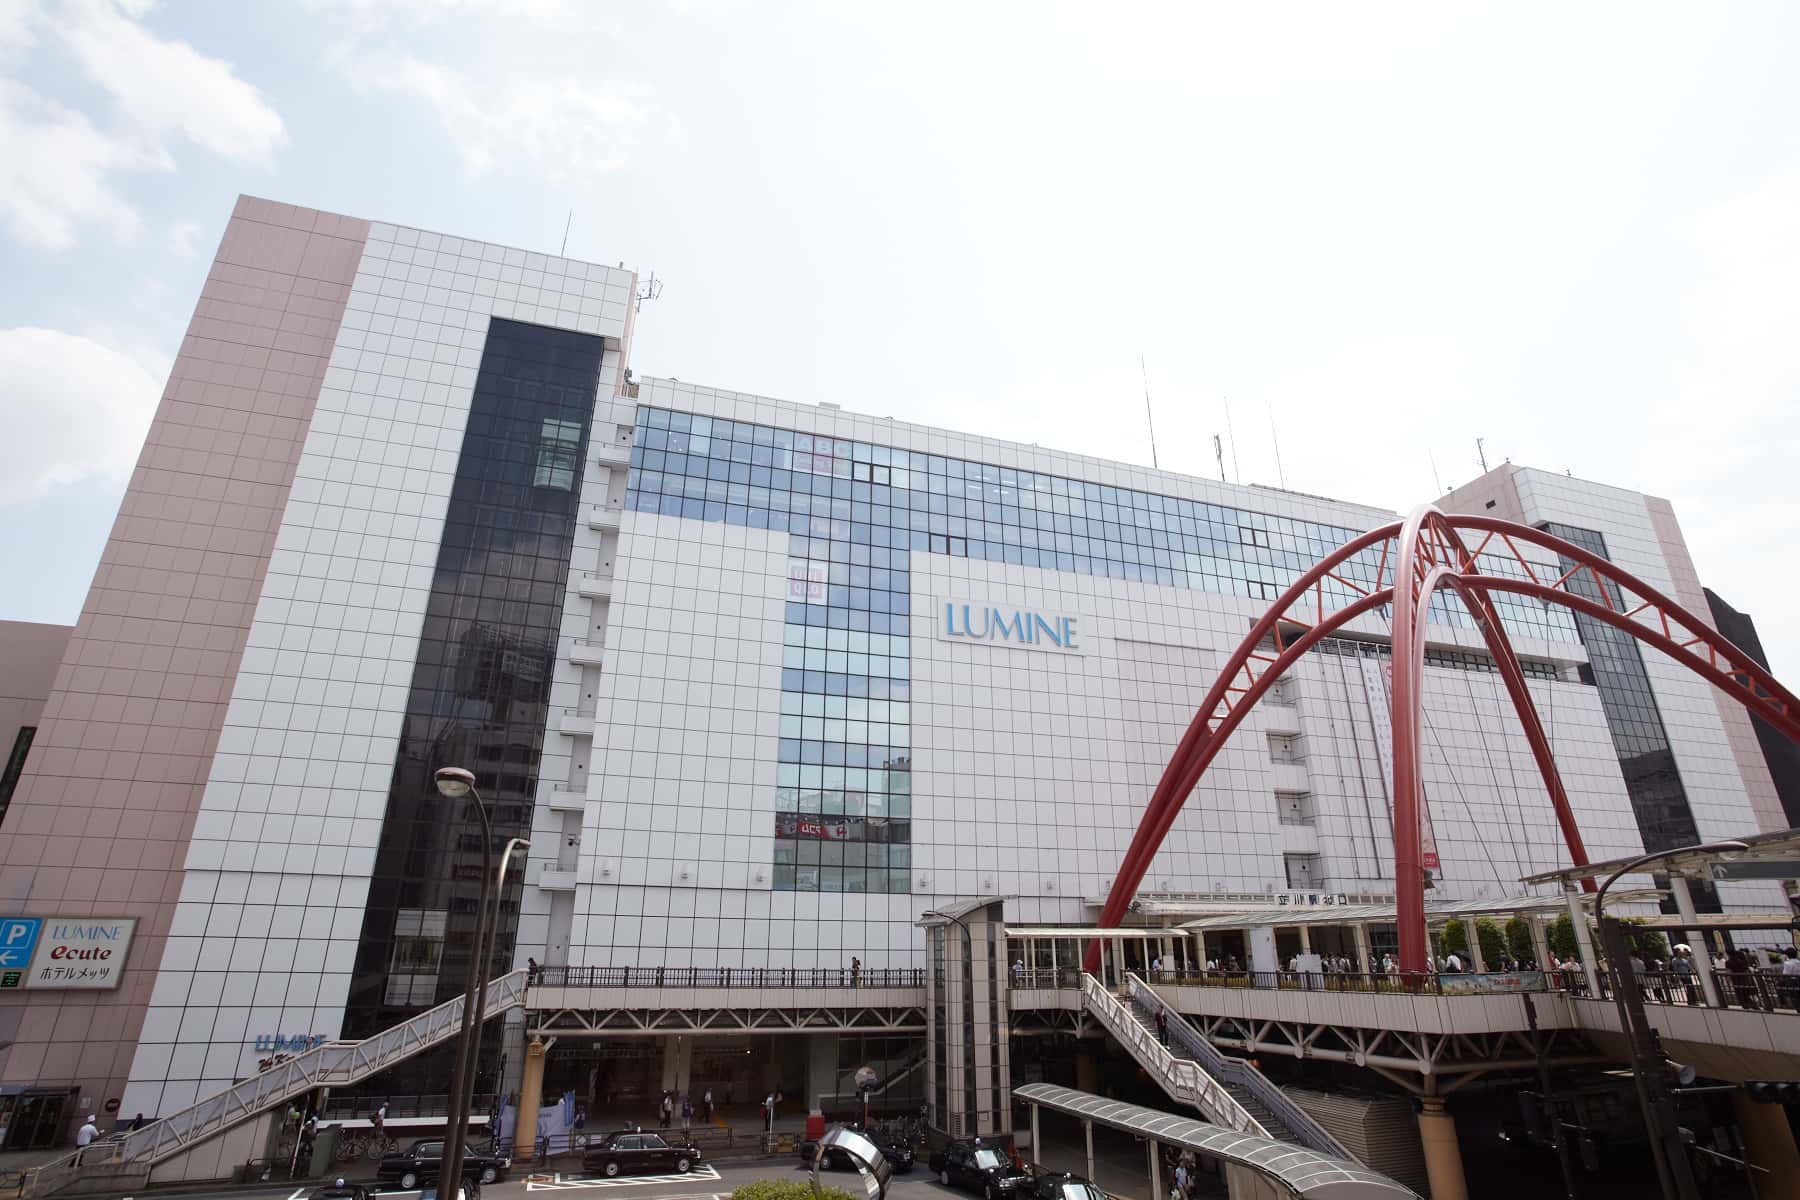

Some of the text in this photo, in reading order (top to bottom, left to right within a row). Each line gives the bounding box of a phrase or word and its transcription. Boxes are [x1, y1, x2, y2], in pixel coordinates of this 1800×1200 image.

[946, 602, 1079, 649] LUMINE
[6, 924, 27, 945] P
[52, 925, 125, 941] LUMINE
[50, 945, 112, 960] ecute
[39, 966, 110, 980] ホテルメッツ
